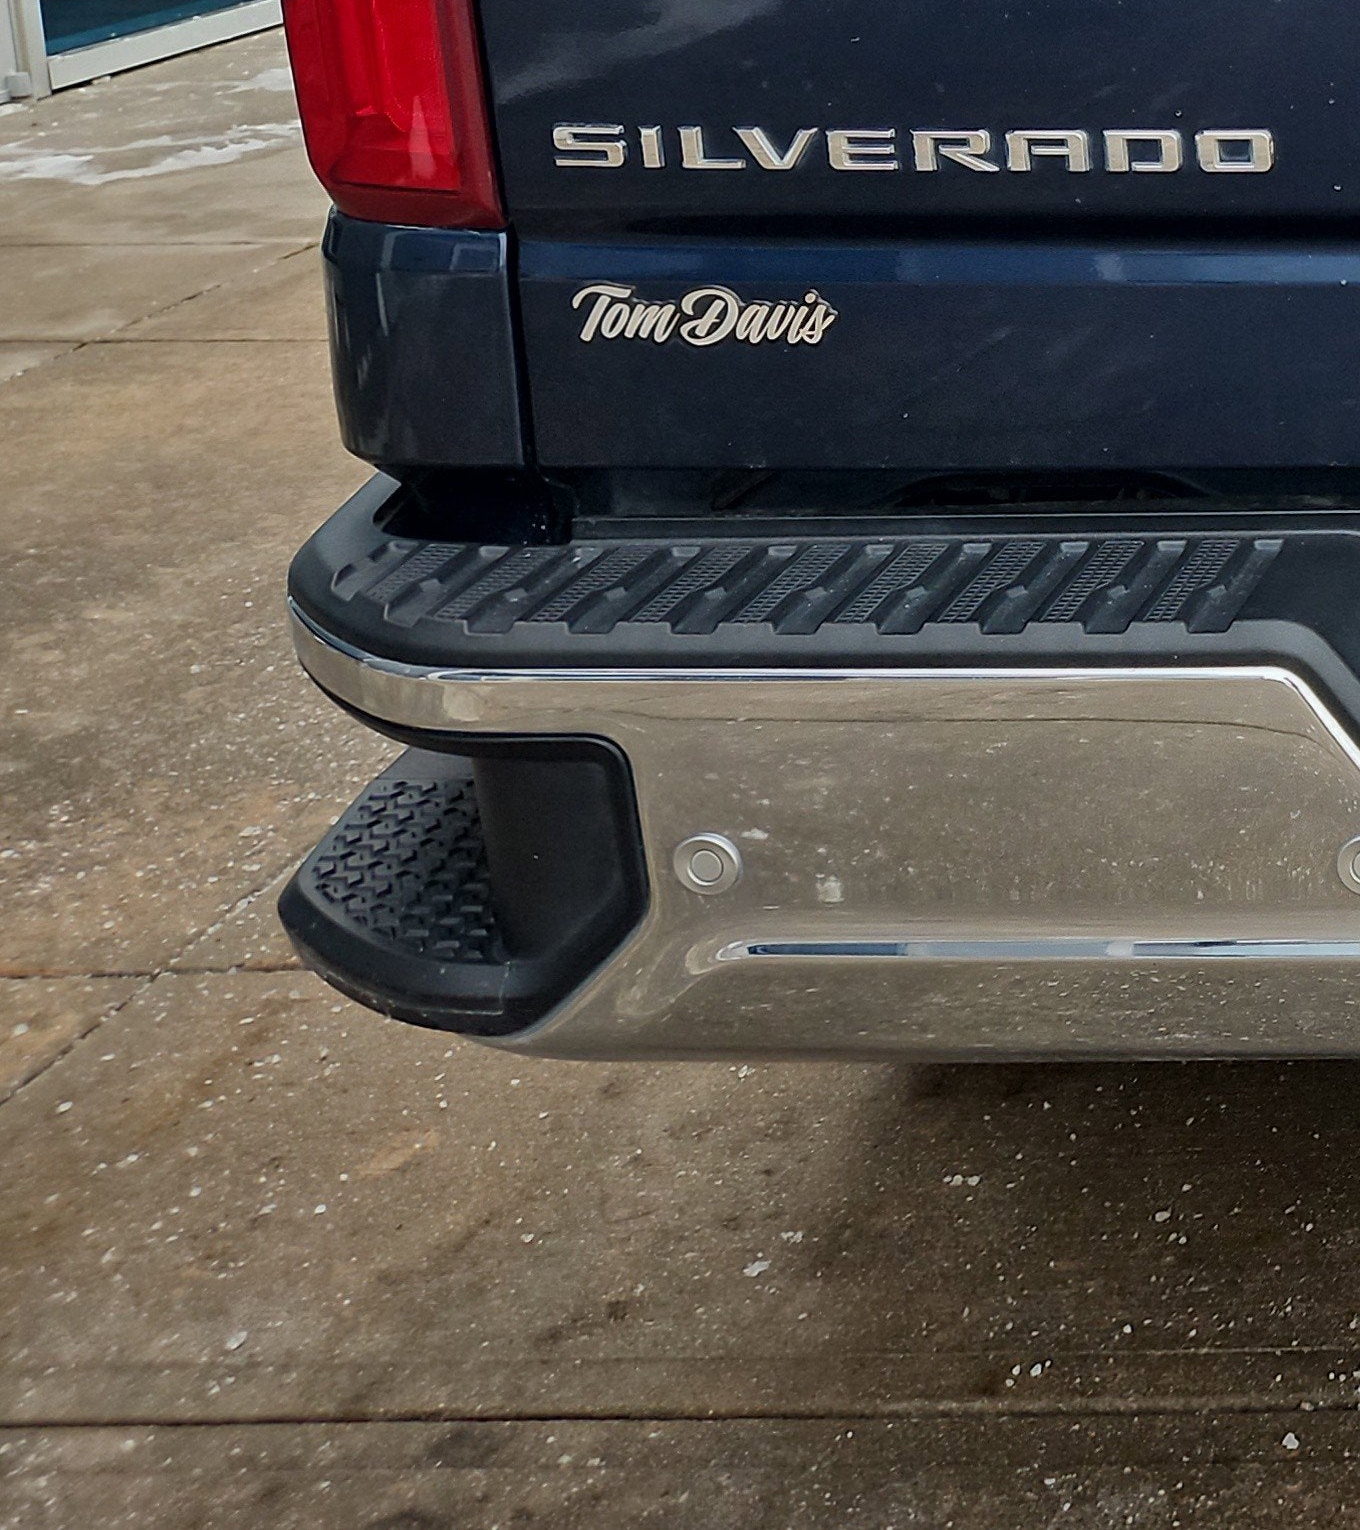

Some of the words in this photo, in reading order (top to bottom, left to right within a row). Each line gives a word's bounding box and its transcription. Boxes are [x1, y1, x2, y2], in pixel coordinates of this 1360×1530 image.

[552, 121, 1277, 174] SILVERADO
[571, 283, 681, 344] Tom
[679, 285, 837, 347] Davis
